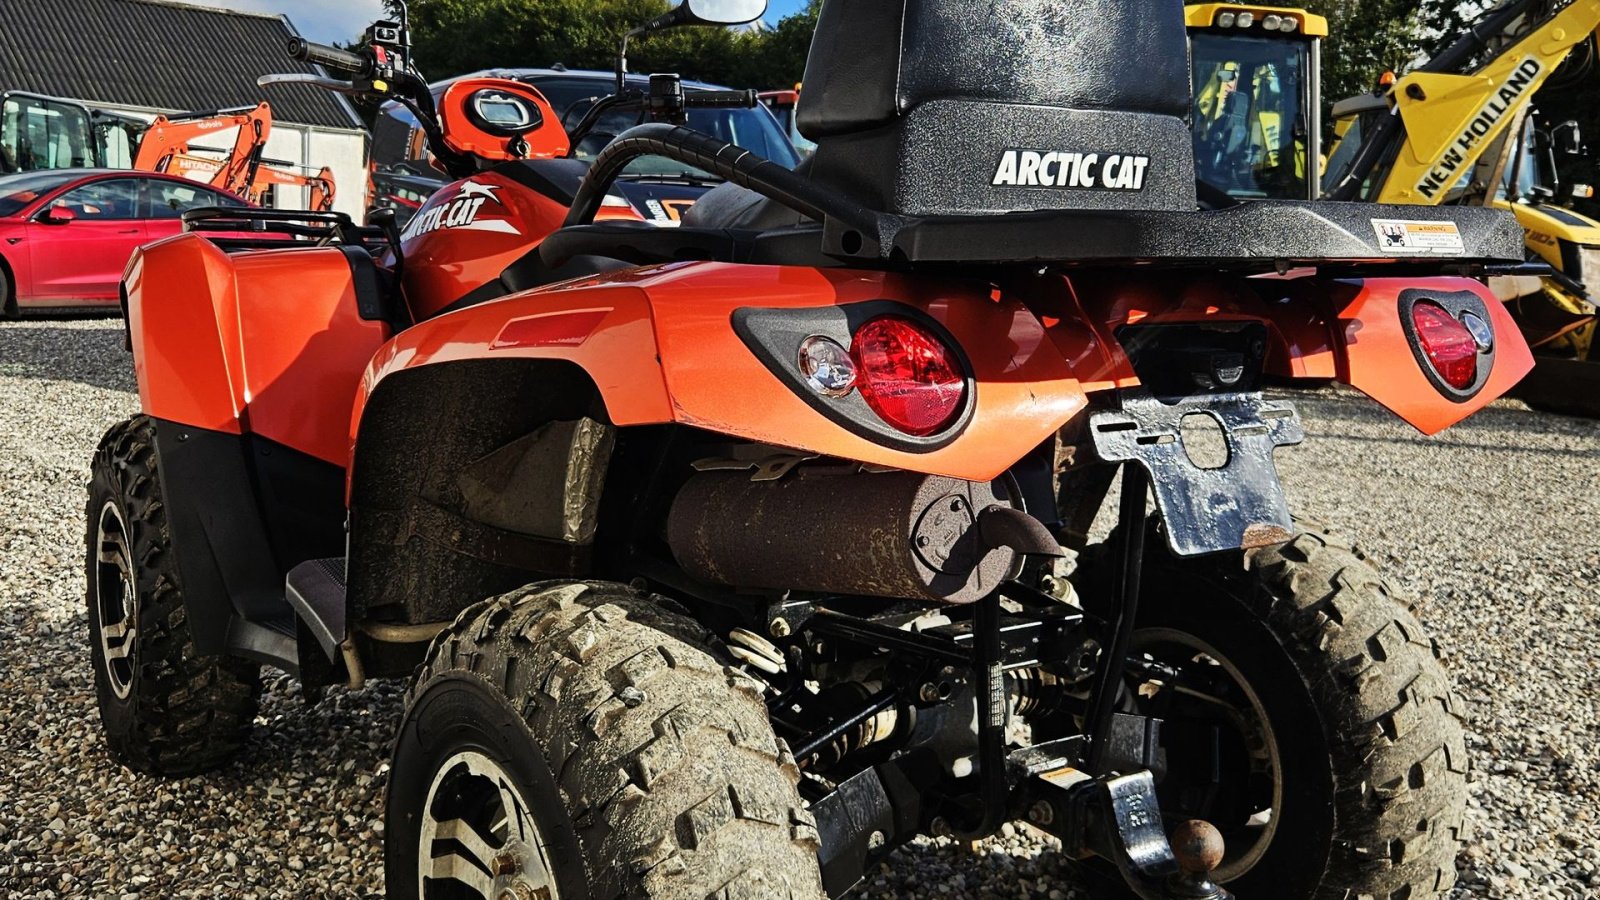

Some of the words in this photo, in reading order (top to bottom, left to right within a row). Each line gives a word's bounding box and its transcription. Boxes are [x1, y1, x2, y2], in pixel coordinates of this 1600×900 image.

[992, 150, 1098, 188] ARCTIC
[1102, 154, 1149, 190] CAT
[1417, 147, 1464, 199] NEW
[1457, 58, 1541, 151] HOLLAND
